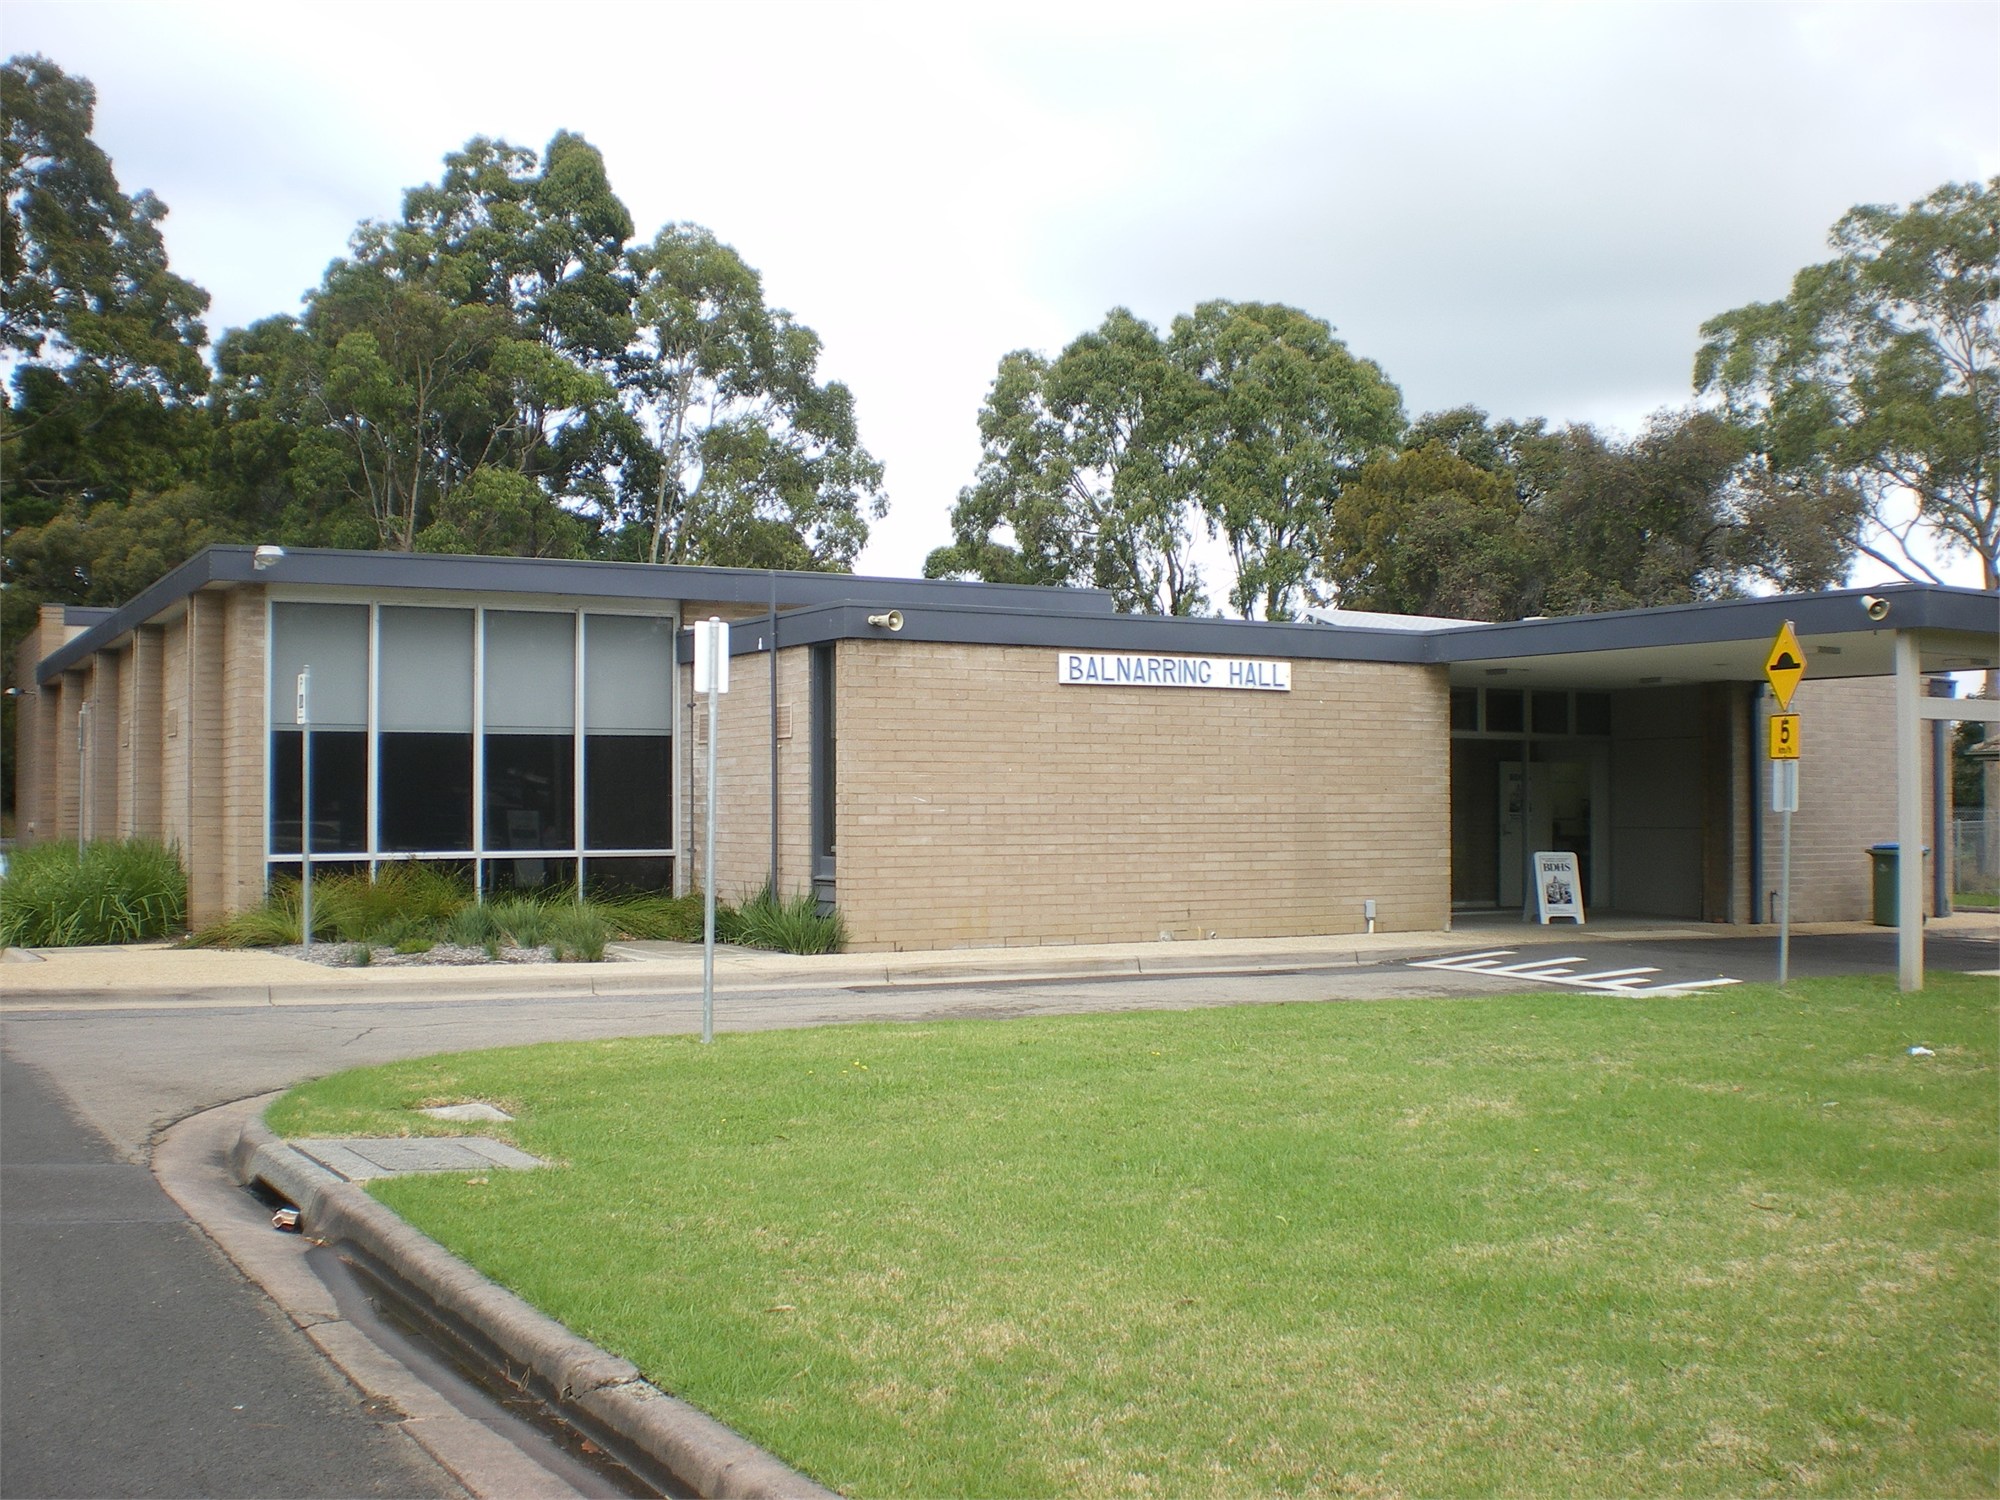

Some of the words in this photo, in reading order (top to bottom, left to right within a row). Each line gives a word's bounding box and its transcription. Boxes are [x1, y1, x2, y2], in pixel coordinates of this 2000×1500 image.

[1069, 656, 1212, 684] BALNARRING
[1230, 661, 1285, 687] HALL
[1780, 720, 1790, 744] 5
[1543, 863, 1571, 872] BDHS
